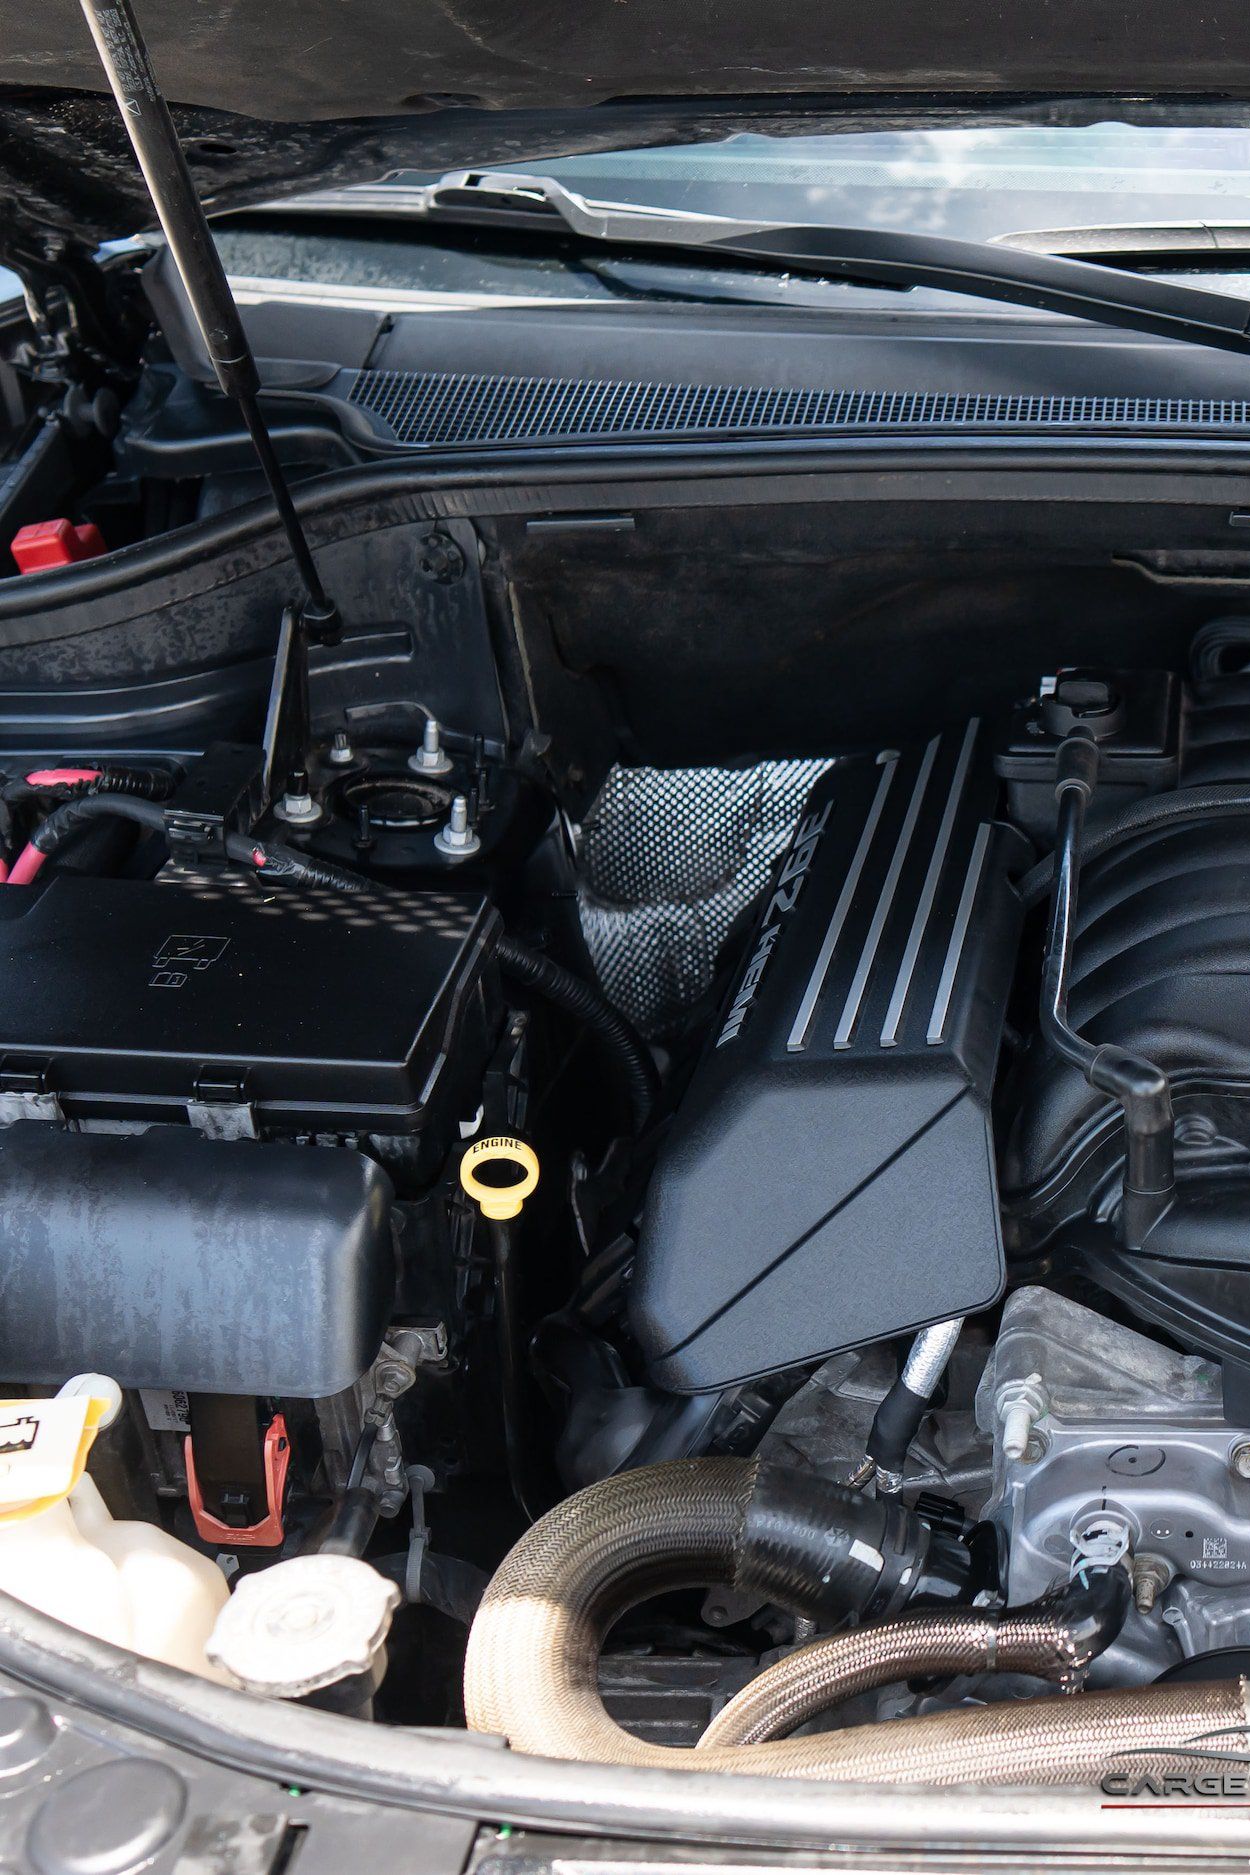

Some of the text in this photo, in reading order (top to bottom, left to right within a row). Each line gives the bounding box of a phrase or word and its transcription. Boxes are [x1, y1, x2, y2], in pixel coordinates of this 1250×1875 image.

[715, 799, 834, 1048] 392 HEMI
[472, 1138, 522, 1154] ENGINE
